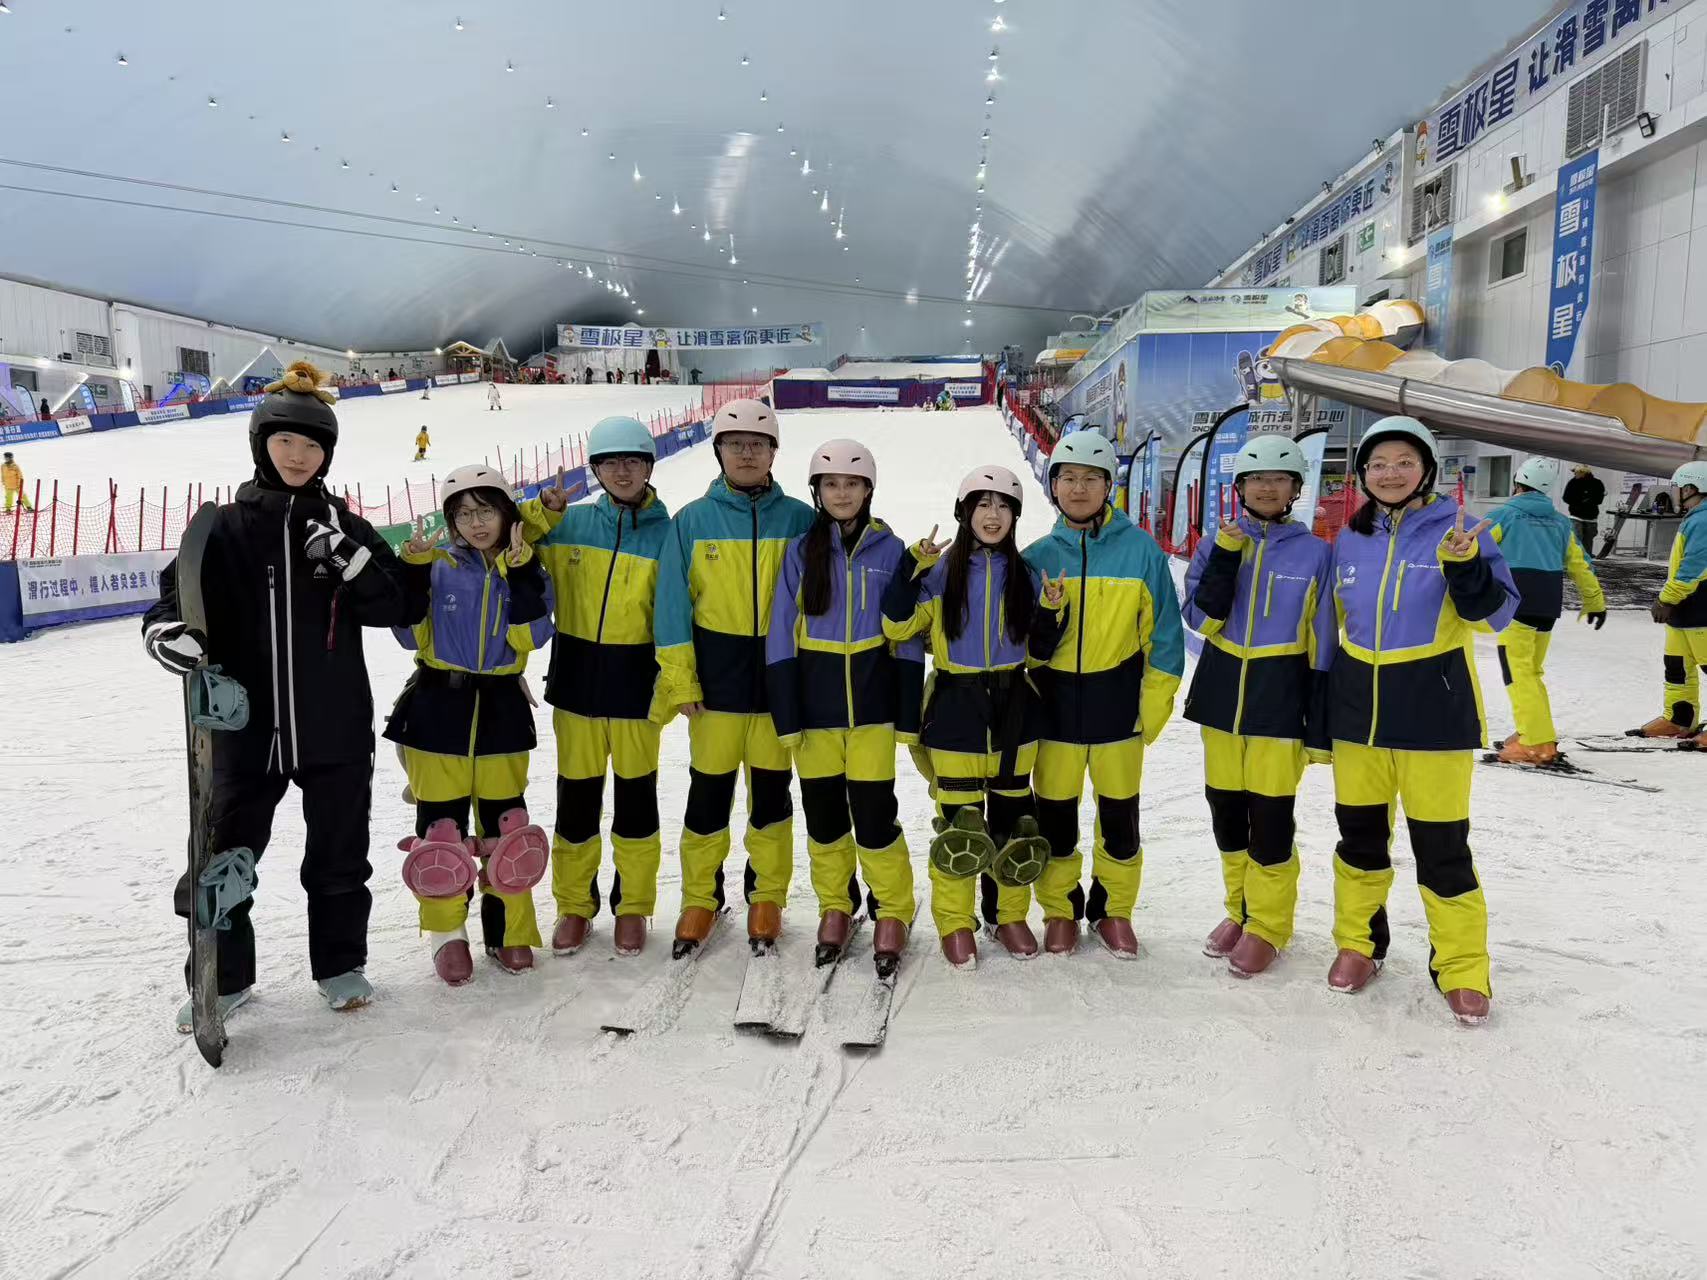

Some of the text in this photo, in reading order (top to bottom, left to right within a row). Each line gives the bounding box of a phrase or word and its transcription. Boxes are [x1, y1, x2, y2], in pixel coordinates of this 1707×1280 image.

[1436, 0, 1669, 162] 雪极星 让滑雪离
[1552, 196, 1582, 340] 雪极星
[580, 327, 791, 347] 雪极星 让滑雪离你更近
[1261, 424, 1282, 432] CITY
